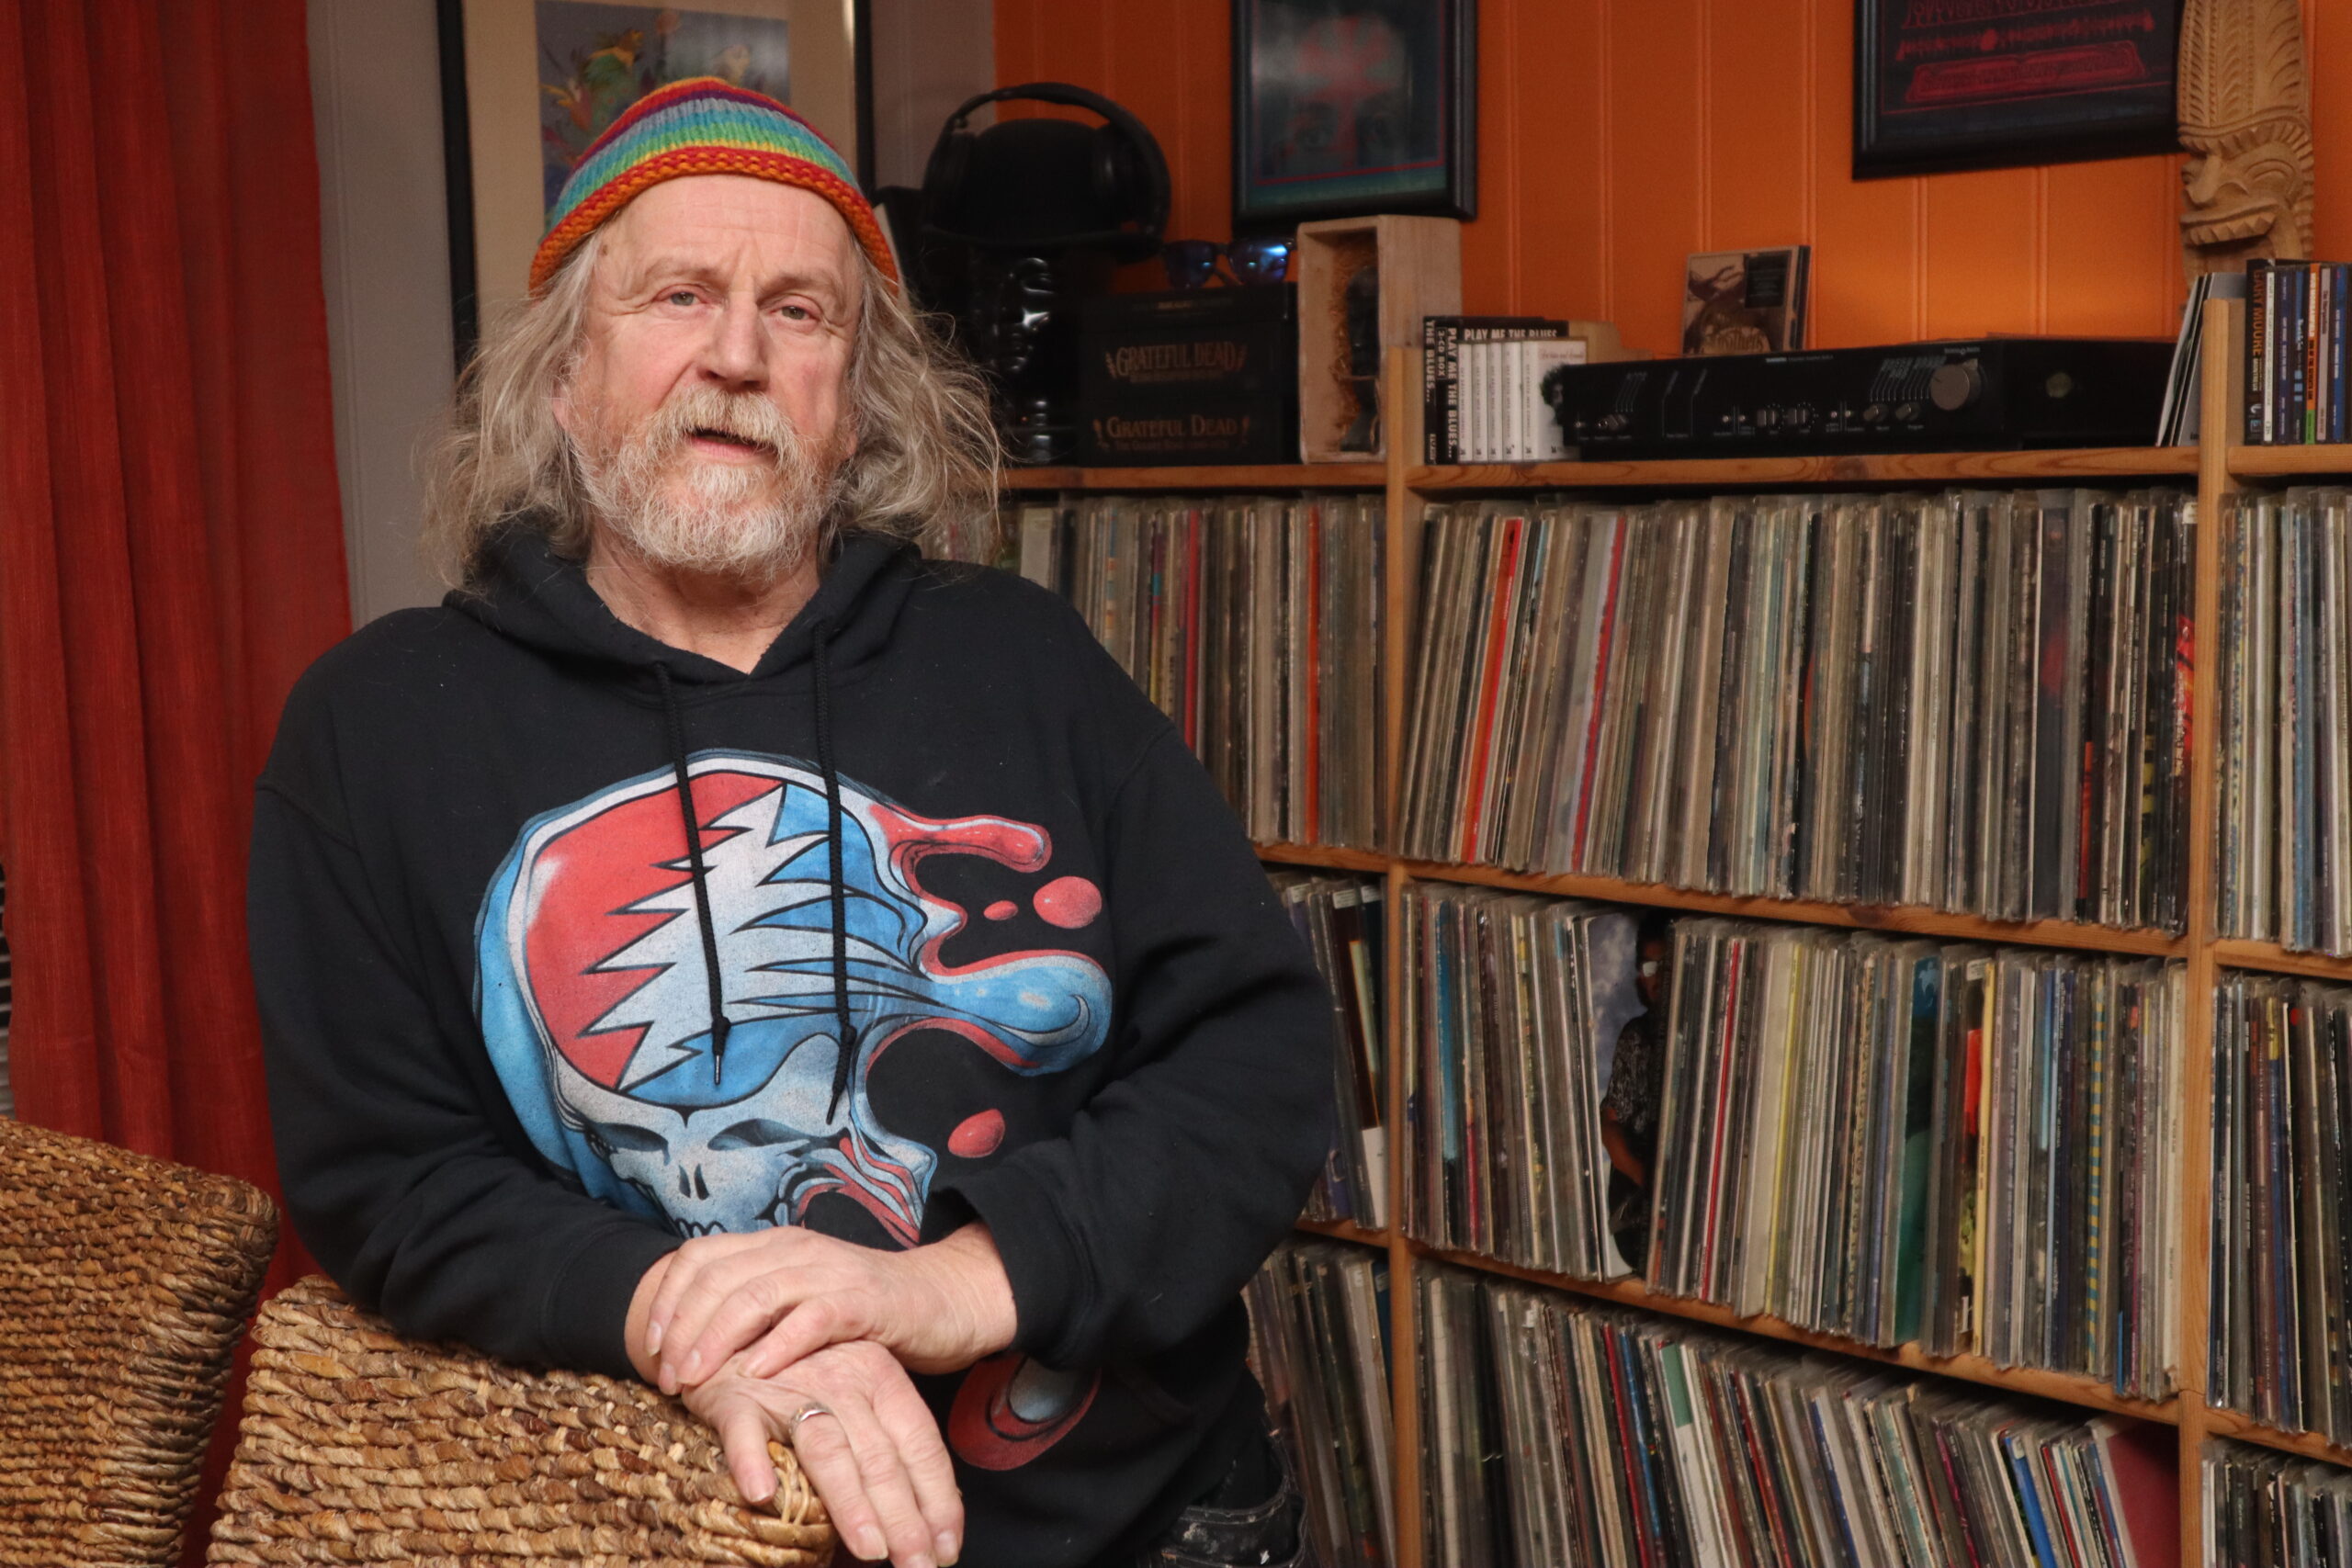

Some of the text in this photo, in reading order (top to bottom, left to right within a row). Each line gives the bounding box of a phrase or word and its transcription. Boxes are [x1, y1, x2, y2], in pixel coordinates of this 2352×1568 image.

[1426, 321, 1435, 345] THE
[1447, 327, 1457, 357] PLAY
[1464, 328, 1488, 341] PLAY
[1115, 344, 1191, 377] GRATEFUL
[1194, 341, 1237, 372] DEAD
[1447, 360, 1457, 378] ME
[1447, 382, 1457, 405] THE
[1106, 414, 1238, 438] GRATEFUL DEAD
